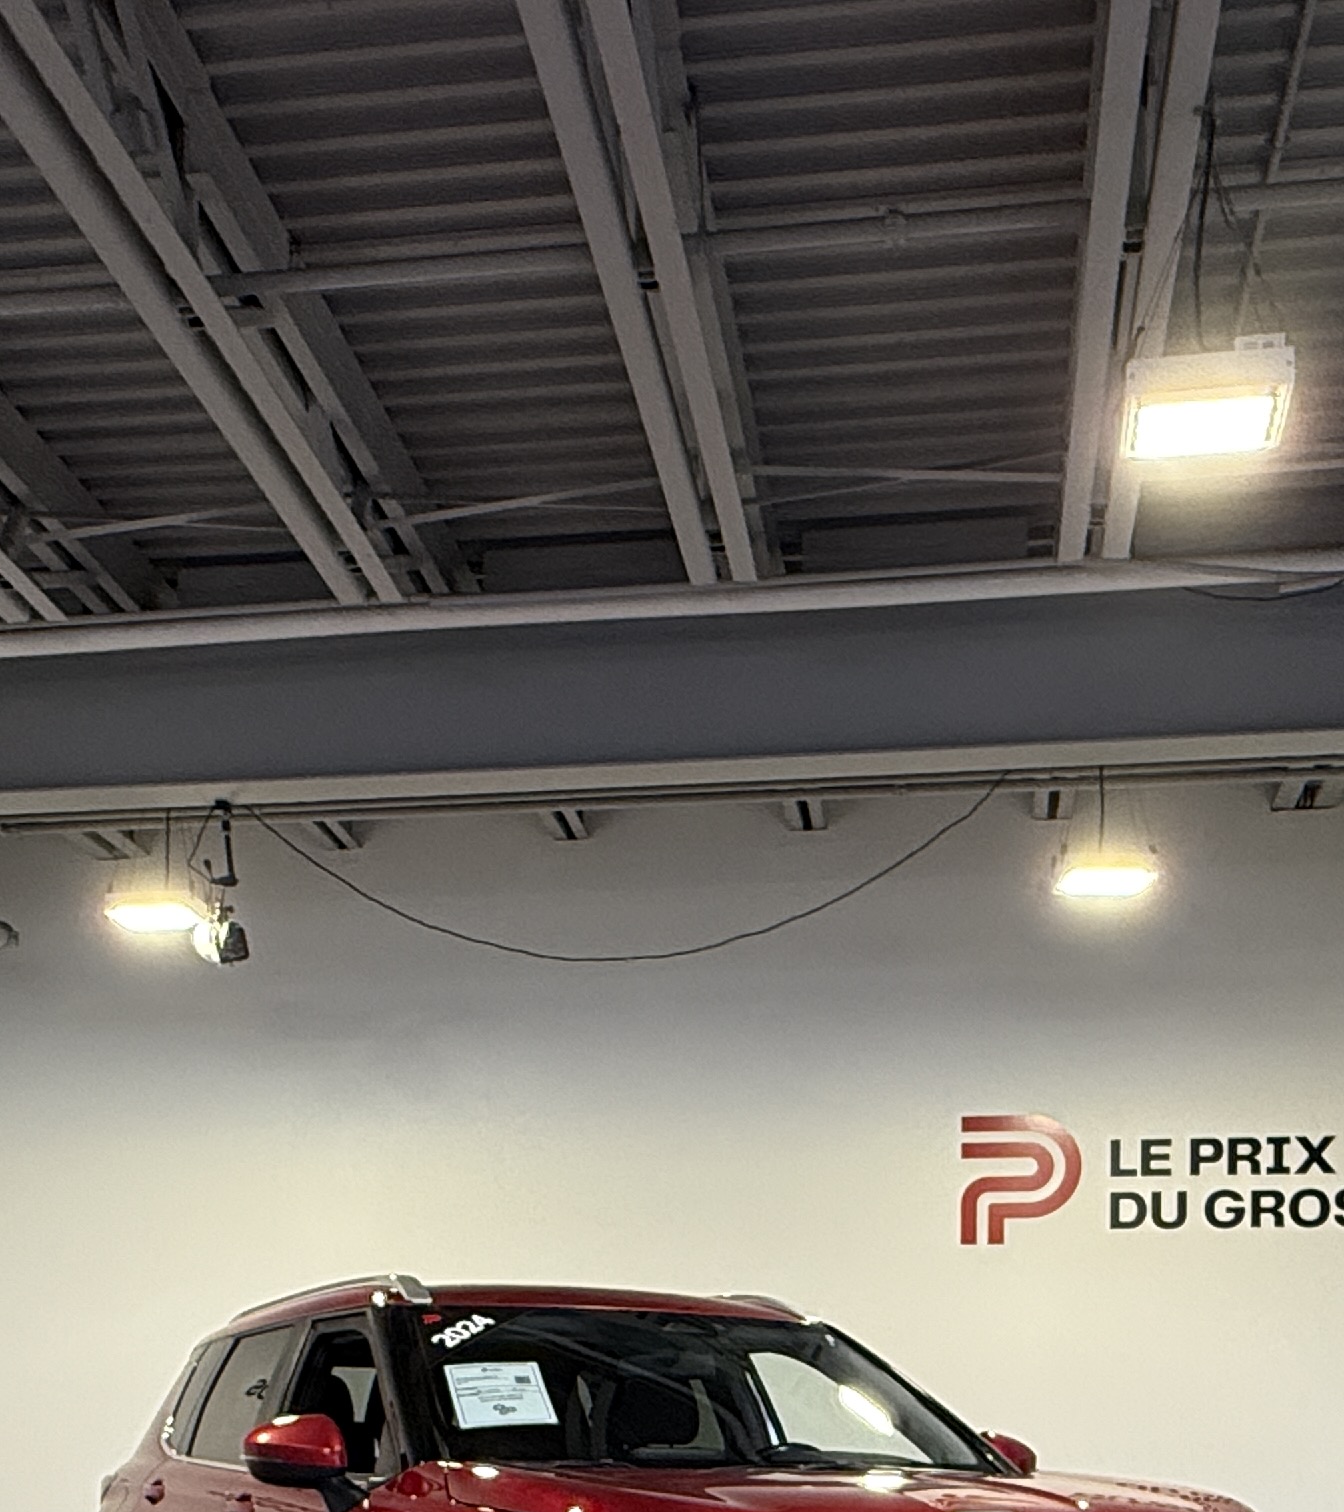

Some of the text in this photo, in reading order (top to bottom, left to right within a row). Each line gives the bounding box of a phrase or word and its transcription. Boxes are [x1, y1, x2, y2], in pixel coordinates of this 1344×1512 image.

[1109, 1135, 1337, 1177] LE PRIX
[1109, 1190, 1188, 1230] DU
[430, 1313, 496, 1349] 2024
